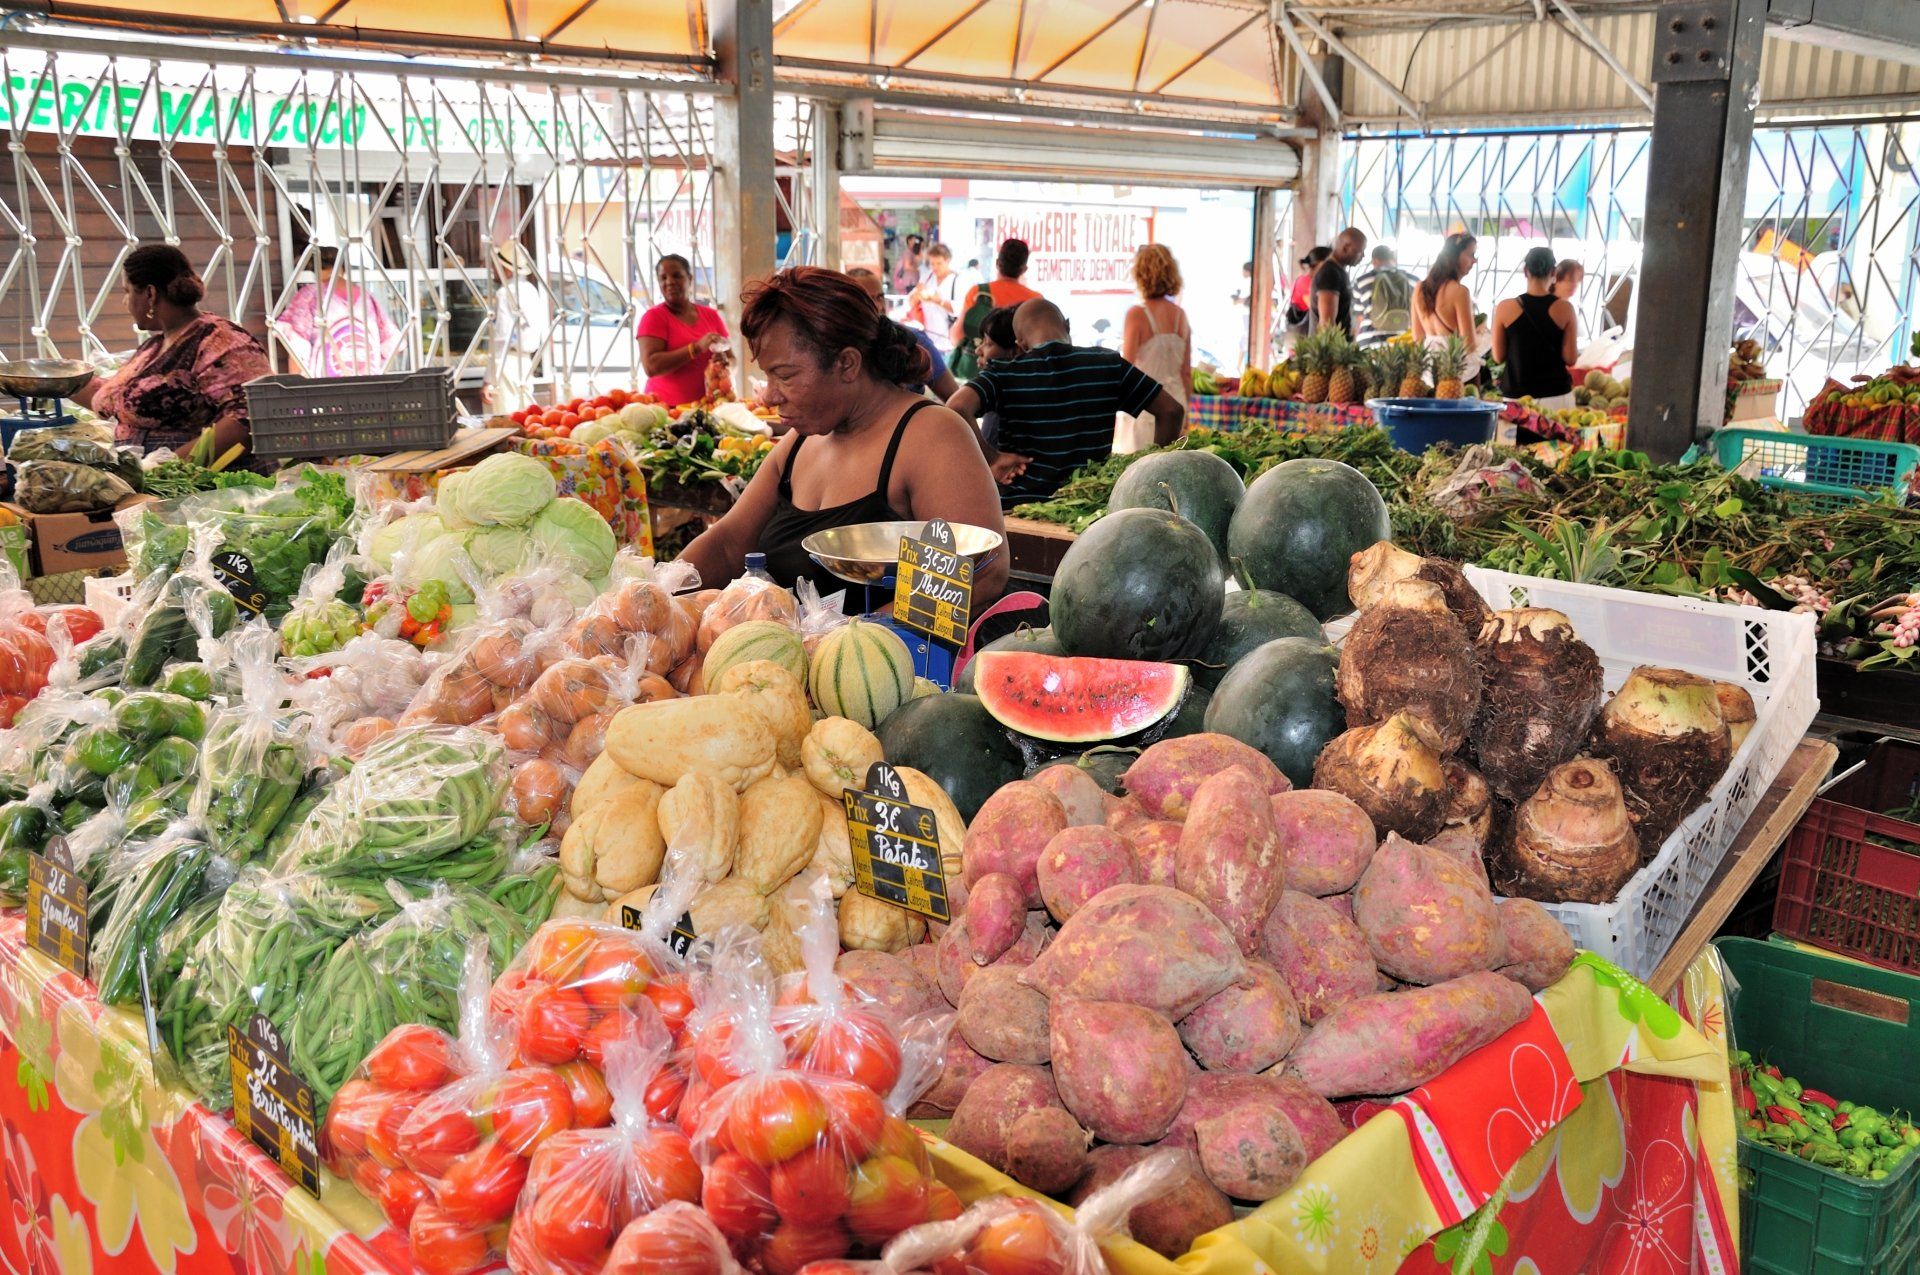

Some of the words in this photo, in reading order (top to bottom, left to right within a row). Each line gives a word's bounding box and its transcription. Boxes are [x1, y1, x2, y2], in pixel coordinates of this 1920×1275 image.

[153, 91, 254, 139] MAN
[269, 99, 366, 145] COCO
[1084, 213, 1136, 253] TOTALE
[931, 521, 949, 544] 1Kg
[227, 554, 249, 574] 1Kg
[900, 539, 918, 564] Prix
[877, 765, 900, 798] 1Kg
[844, 794, 869, 823] Prix
[874, 801, 902, 834] 3€
[29, 854, 44, 884] Prix
[228, 1026, 250, 1067] Prix
[256, 1018, 279, 1052] 1Kg
